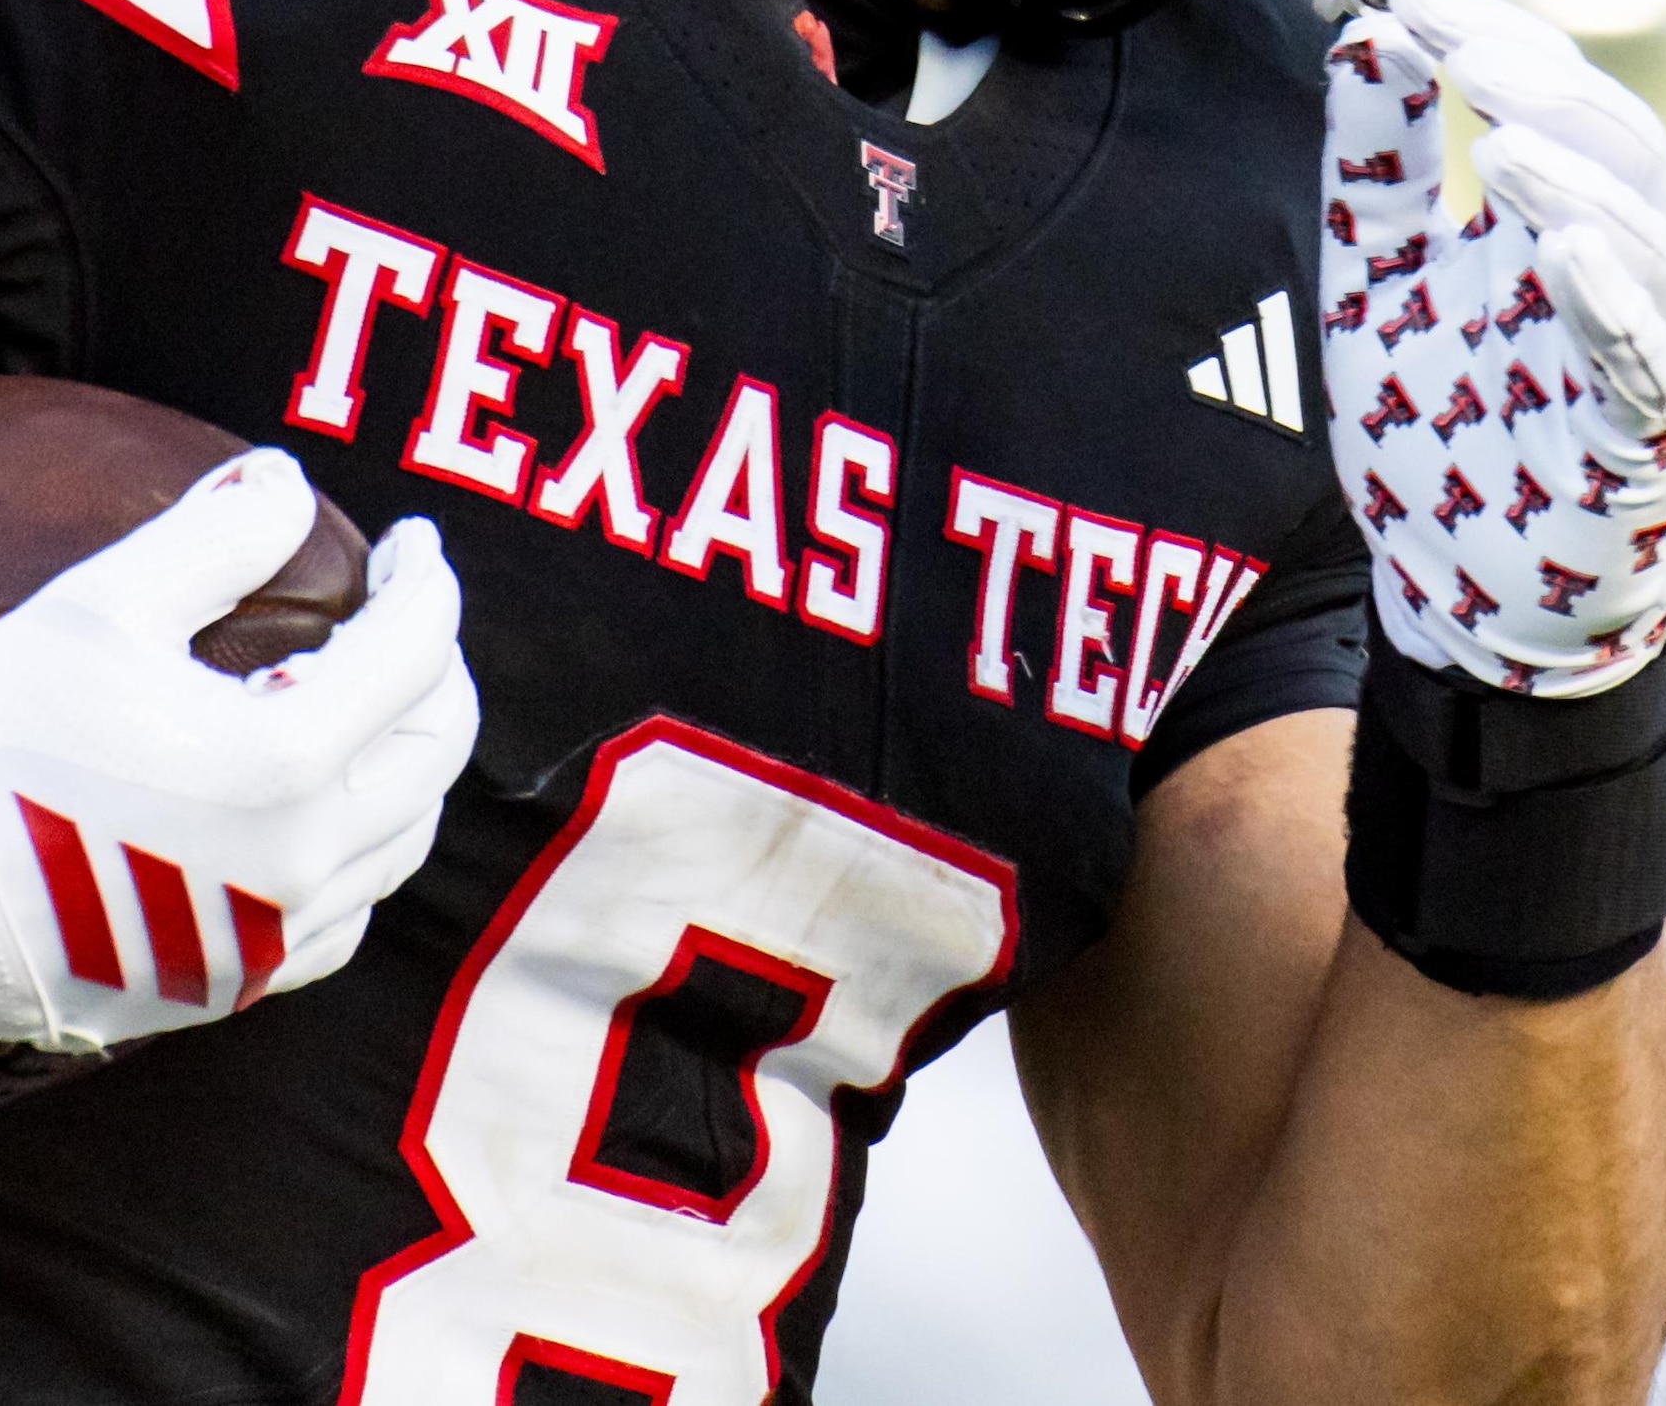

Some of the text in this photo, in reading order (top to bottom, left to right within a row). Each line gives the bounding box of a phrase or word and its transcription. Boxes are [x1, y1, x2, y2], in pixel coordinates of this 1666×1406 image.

[281, 191, 1270, 752] TEXAS TECH
[336, 714, 1021, 1406] 8
